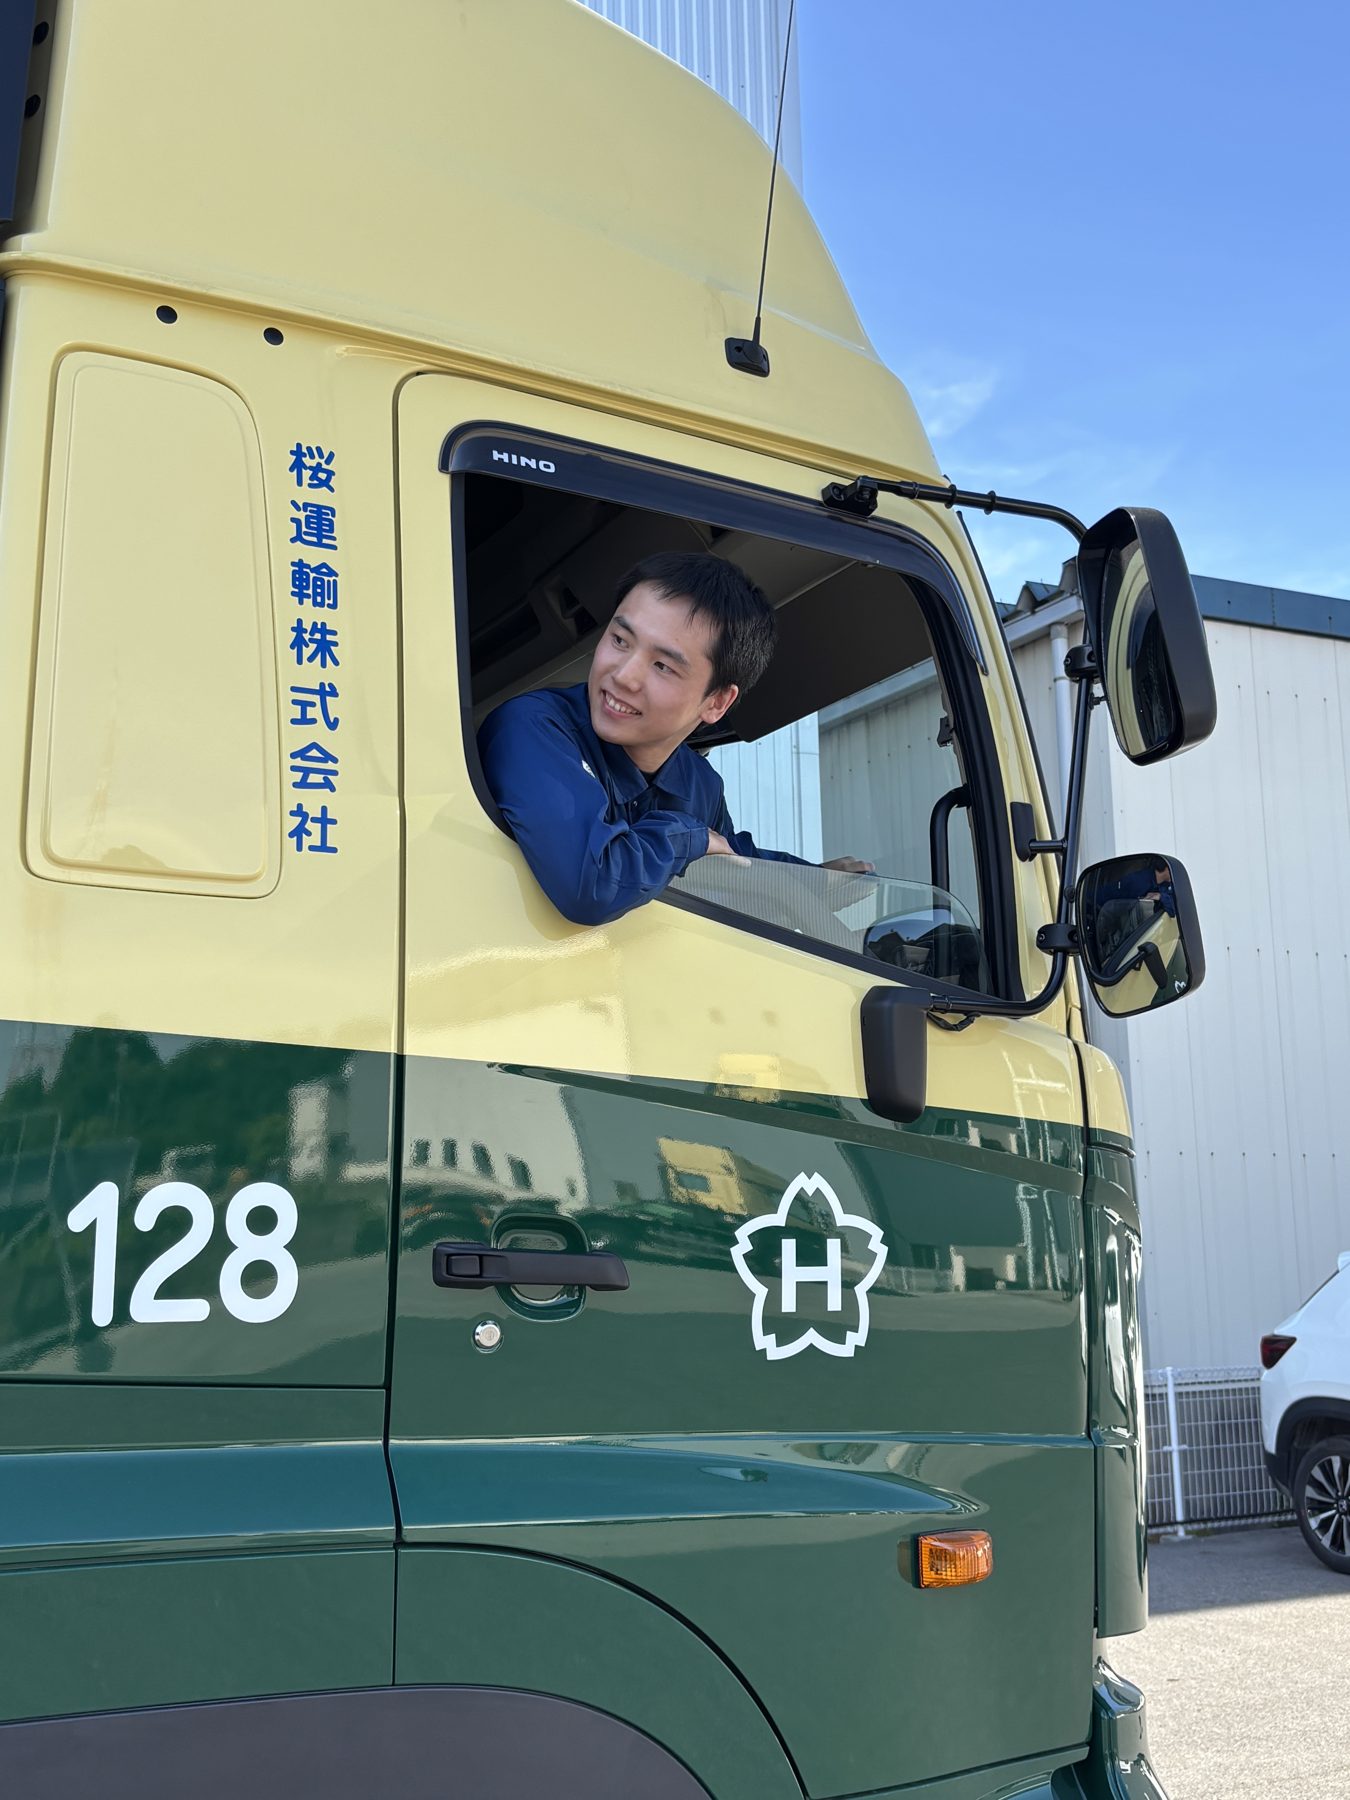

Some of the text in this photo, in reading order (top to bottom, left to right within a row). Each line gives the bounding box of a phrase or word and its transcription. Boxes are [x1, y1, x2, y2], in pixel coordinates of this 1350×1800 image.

[491, 449, 557, 474] HINO
[288, 443, 340, 855] 桜運輸株式会社
[67, 1181, 299, 1327] 128
[781, 1238, 842, 1313] H
